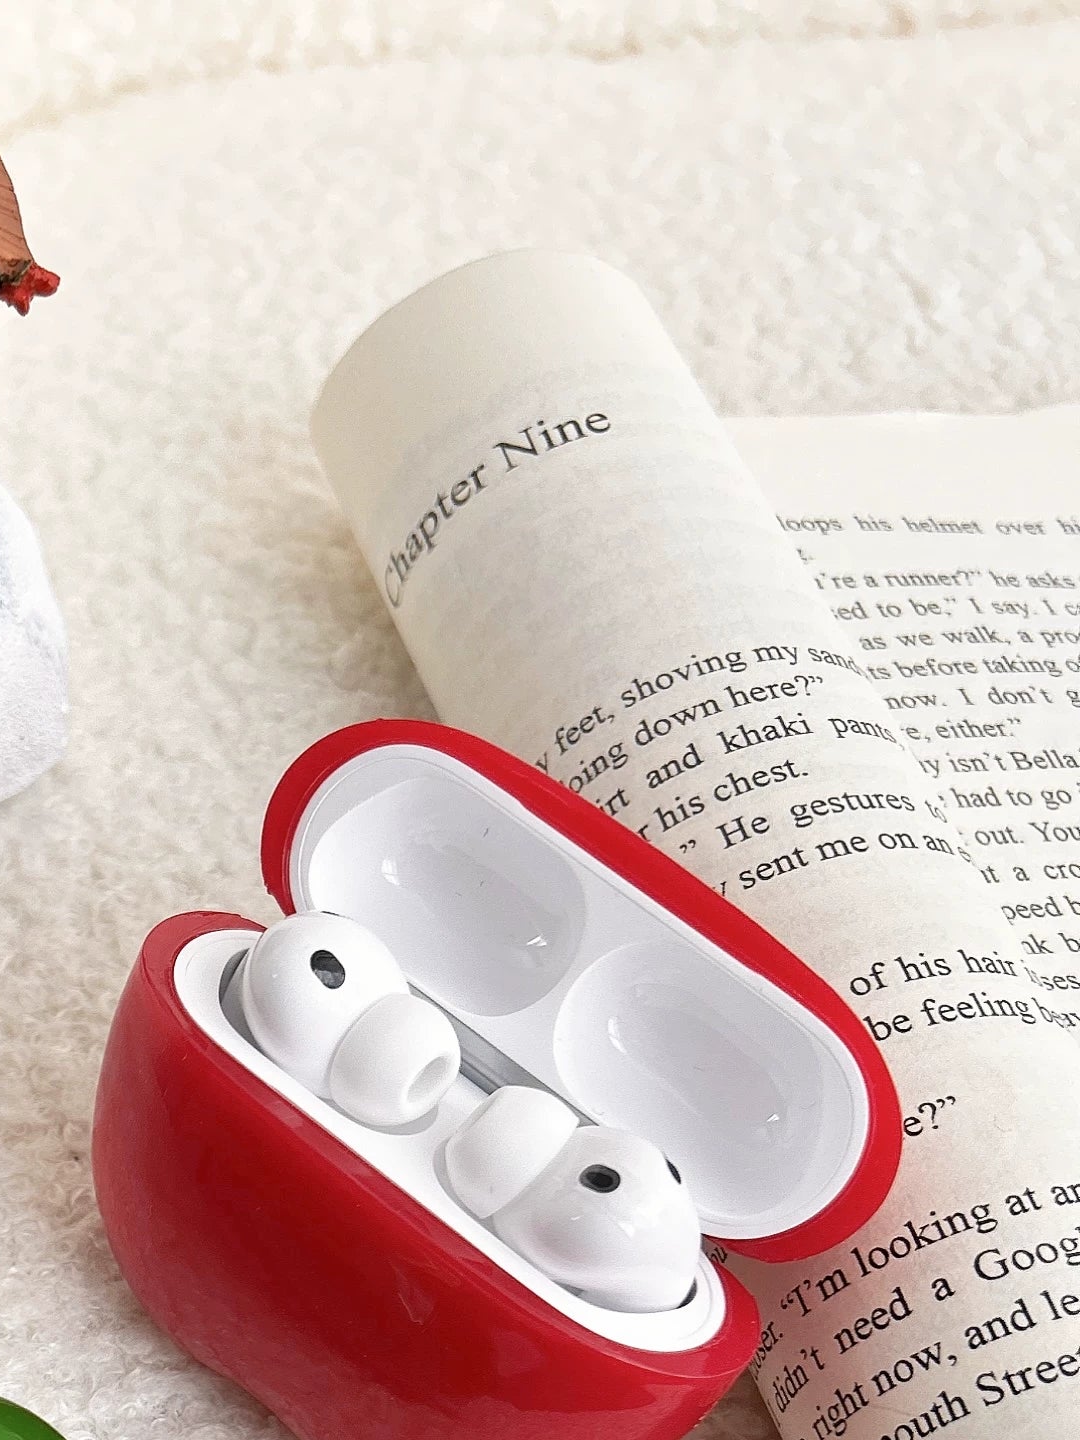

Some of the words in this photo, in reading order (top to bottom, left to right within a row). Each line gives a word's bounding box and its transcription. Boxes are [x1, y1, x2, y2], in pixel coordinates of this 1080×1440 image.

[384, 464, 487, 608] Chapter
[493, 413, 611, 473] Nine
[853, 515, 893, 532] his
[901, 516, 984, 535] helmet
[995, 520, 1046, 535] over
[863, 575, 880, 588] a
[988, 568, 1021, 588] he
[1025, 571, 1077, 589] asks
[831, 600, 870, 621] ed
[876, 601, 902, 618] to
[968, 598, 984, 615] I
[991, 601, 1038, 619] say.
[1041, 598, 1057, 615] I
[1064, 602, 1080, 616] c
[859, 635, 888, 650] as
[895, 633, 935, 646] we
[941, 626, 1011, 645] walk,
[1017, 630, 1034, 643] a
[1039, 630, 1080, 648] pro
[893, 656, 980, 678] before
[982, 654, 1063, 677] taking
[1065, 656, 1080, 672] o
[554, 704, 615, 756] feet,
[621, 650, 747, 708] shoving
[753, 645, 798, 665] my
[883, 693, 947, 709] now.
[956, 687, 976, 705] I
[987, 686, 1054, 704] don’t
[559, 742, 628, 793] oing
[634, 697, 723, 746] down
[723, 675, 824, 708] here?”
[646, 742, 704, 789] and
[716, 712, 814, 754] khaki
[900, 727, 932, 743] e,
[948, 751, 1007, 773] isn’t
[1007, 749, 1080, 771] Bella
[653, 795, 705, 832] his
[713, 758, 809, 803] chest.
[950, 786, 1002, 808] had
[1006, 789, 1033, 806] to
[1040, 790, 1072, 811] go
[715, 815, 770, 850] He
[789, 791, 916, 827] gestures
[974, 826, 1024, 846] out.
[739, 845, 809, 890] sent
[818, 835, 870, 862] me
[877, 831, 919, 850] on
[922, 834, 956, 856] an
[1013, 866, 1030, 882] a
[1001, 895, 1063, 926] peed
[849, 961, 888, 996] of
[894, 952, 952, 983] his
[957, 949, 1018, 977] hair
[863, 1015, 913, 1042] be
[920, 992, 1036, 1026] feeling
[903, 1095, 956, 1137] e?”
[850, 1203, 998, 1278] looking
[1005, 1186, 1042, 1216] at
[772, 1345, 825, 1413] didn’t
[833, 1286, 913, 1354] need
[930, 1277, 956, 1301] a
[973, 1225, 1080, 1281] Goog
[871, 1341, 959, 1397] now,
[964, 1297, 1038, 1351] and
[976, 1345, 1080, 1407] Stree
